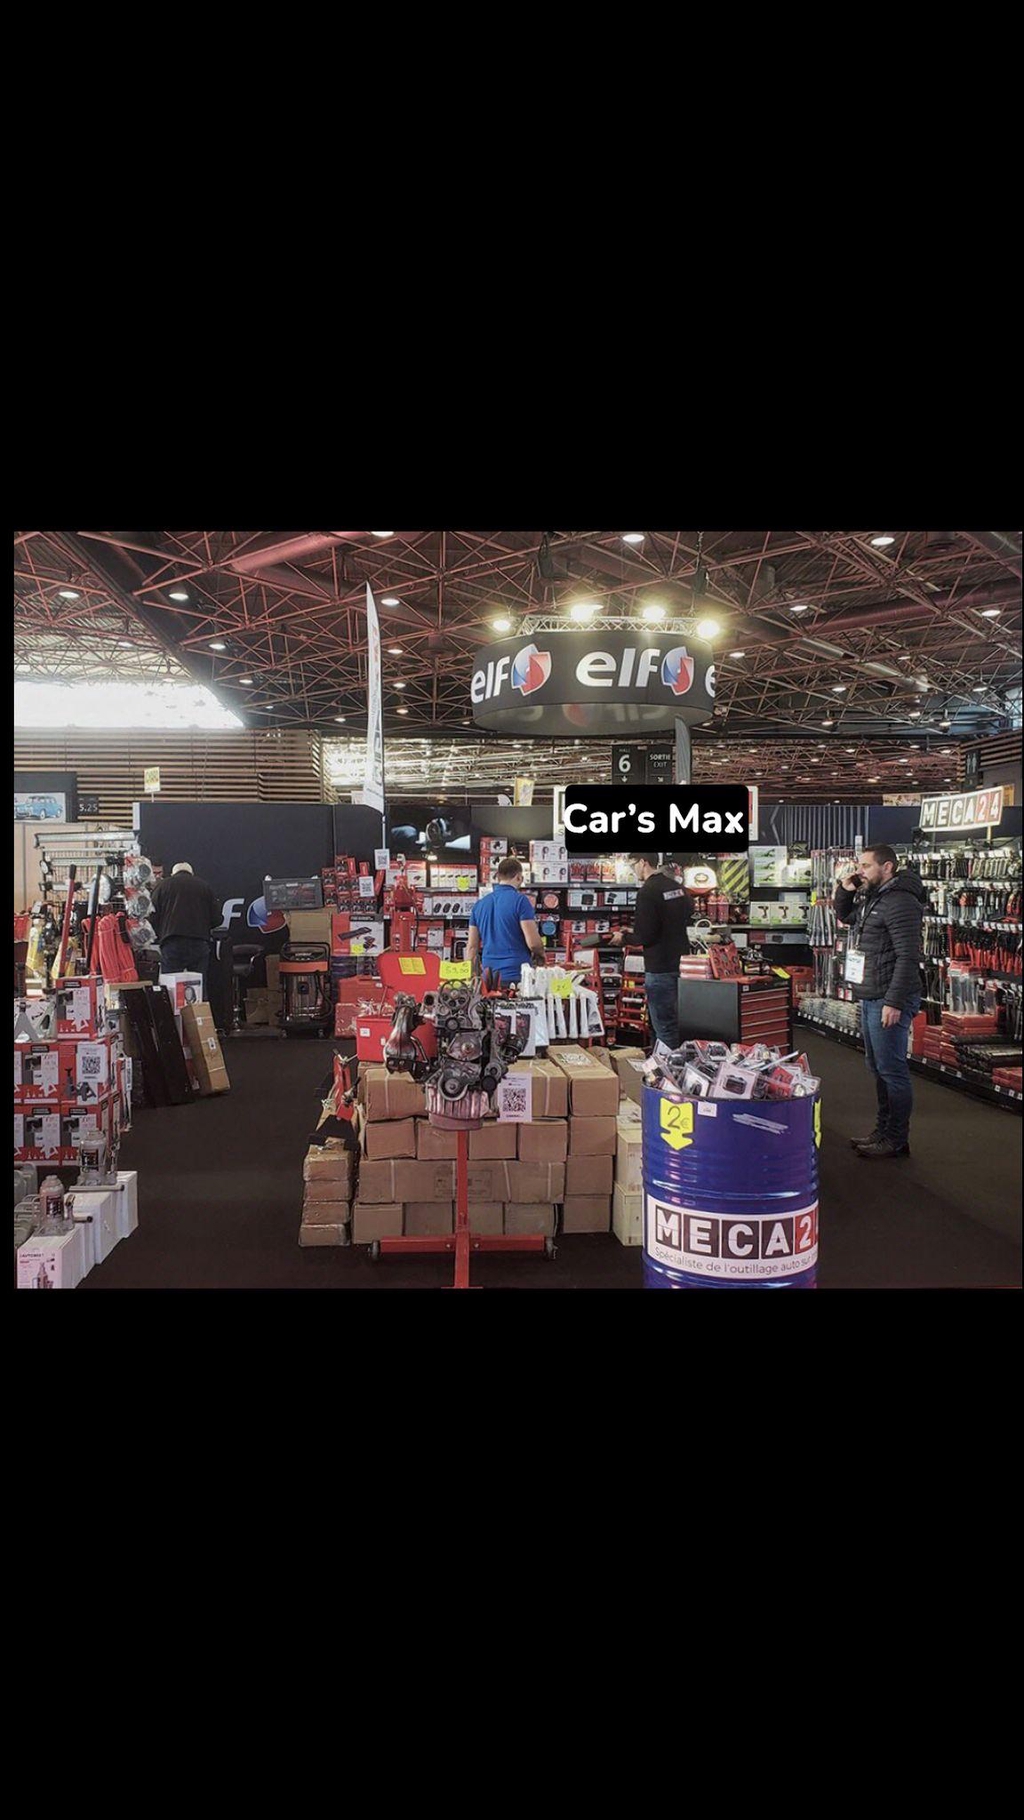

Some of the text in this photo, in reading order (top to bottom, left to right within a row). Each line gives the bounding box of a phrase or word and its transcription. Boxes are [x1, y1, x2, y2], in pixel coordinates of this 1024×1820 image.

[470, 655, 511, 704] elf
[575, 647, 661, 688] elf
[618, 754, 631, 773] 6
[922, 792, 1000, 826] MECA24
[656, 1207, 818, 1257] MECA2
[705, 1261, 721, 1273] de
[780, 1260, 800, 1272] auto
